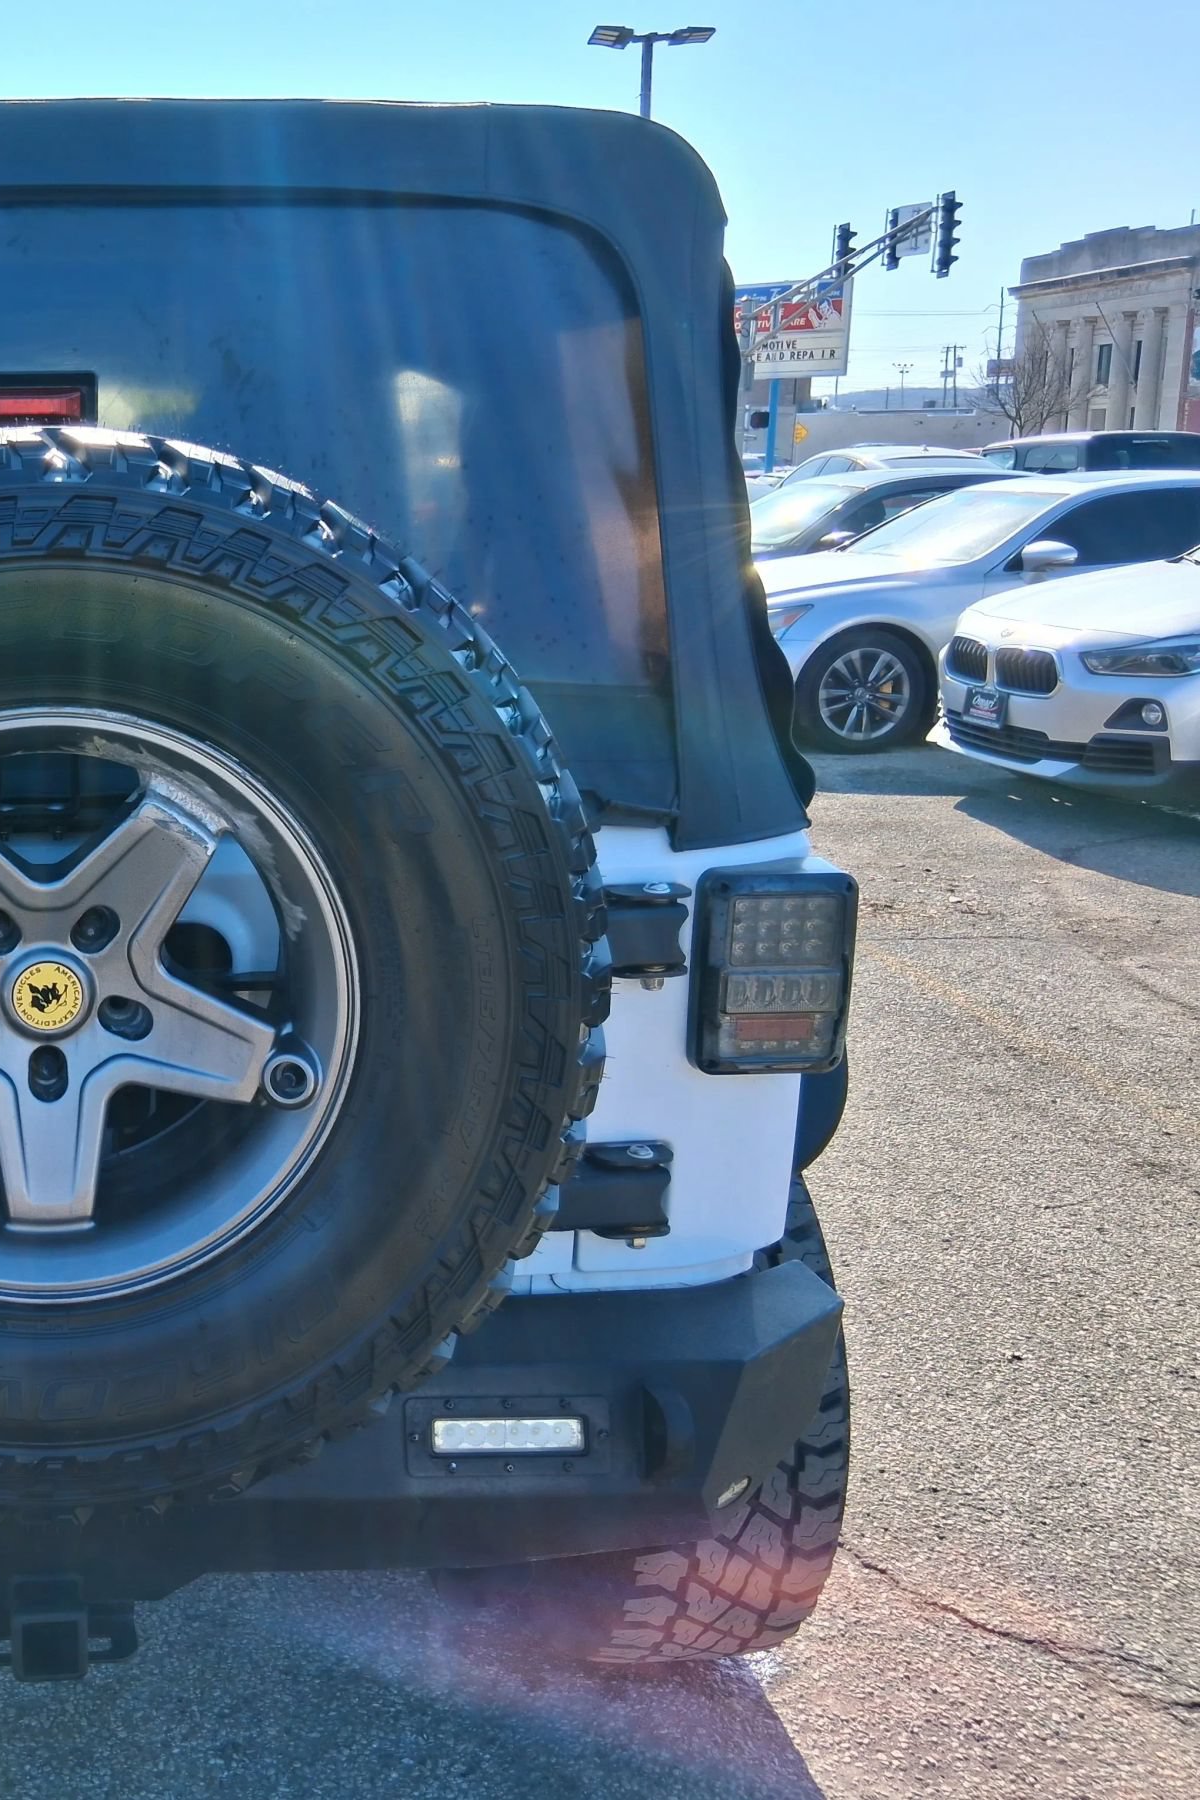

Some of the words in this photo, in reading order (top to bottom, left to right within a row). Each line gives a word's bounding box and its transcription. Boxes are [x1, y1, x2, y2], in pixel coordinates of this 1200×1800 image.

[15, 966, 42, 1008] VEHICLES
[53, 966, 80, 1010] AMERICAN
[20, 1008, 75, 1027] EXPEDITION
